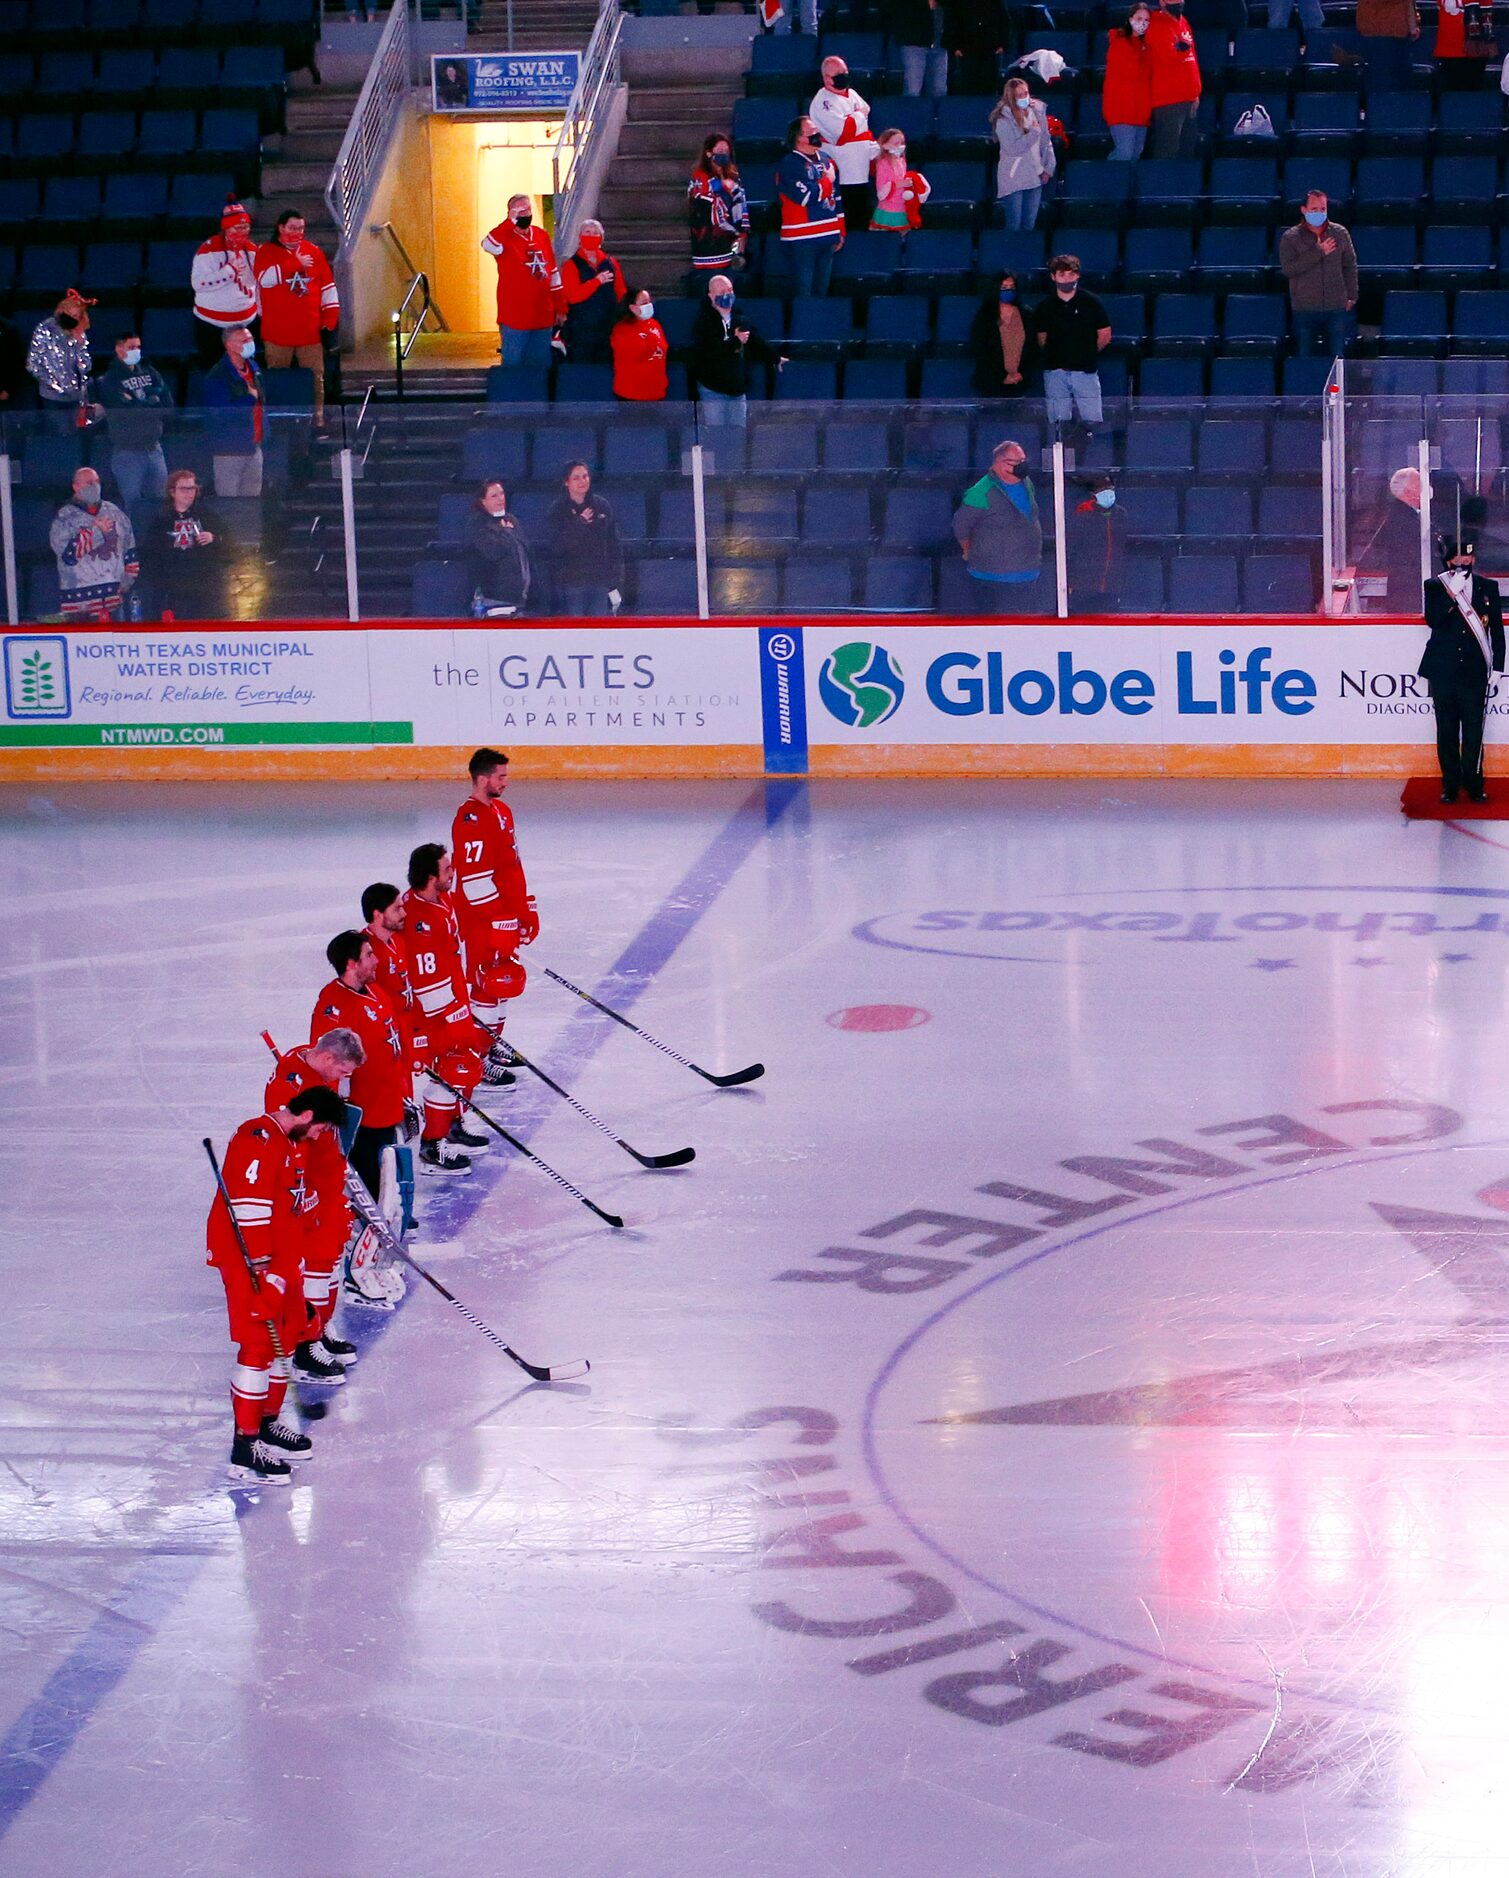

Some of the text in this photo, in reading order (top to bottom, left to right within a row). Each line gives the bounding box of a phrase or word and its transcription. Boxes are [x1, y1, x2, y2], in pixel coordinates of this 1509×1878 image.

[509, 61, 564, 76] SWAN
[475, 75, 574, 87] ROOFING, L.L.C.
[76, 643, 314, 658] NORTH TEXAS MUNICIPAL
[118, 661, 272, 676] WATER DISTRICT
[433, 655, 656, 690] the GATES
[926, 646, 1317, 716] Globe Life
[79, 685, 316, 706] Regional. Reliable. Everyday.
[776, 664, 792, 745] WARRIOR
[504, 712, 706, 728] APARTMENTS
[101, 728, 224, 744] NTMWD.COM
[464, 840, 483, 863] 27
[416, 952, 436, 975] 18
[245, 1159, 259, 1184] 4
[772, 1095, 1462, 1294] CENTER
